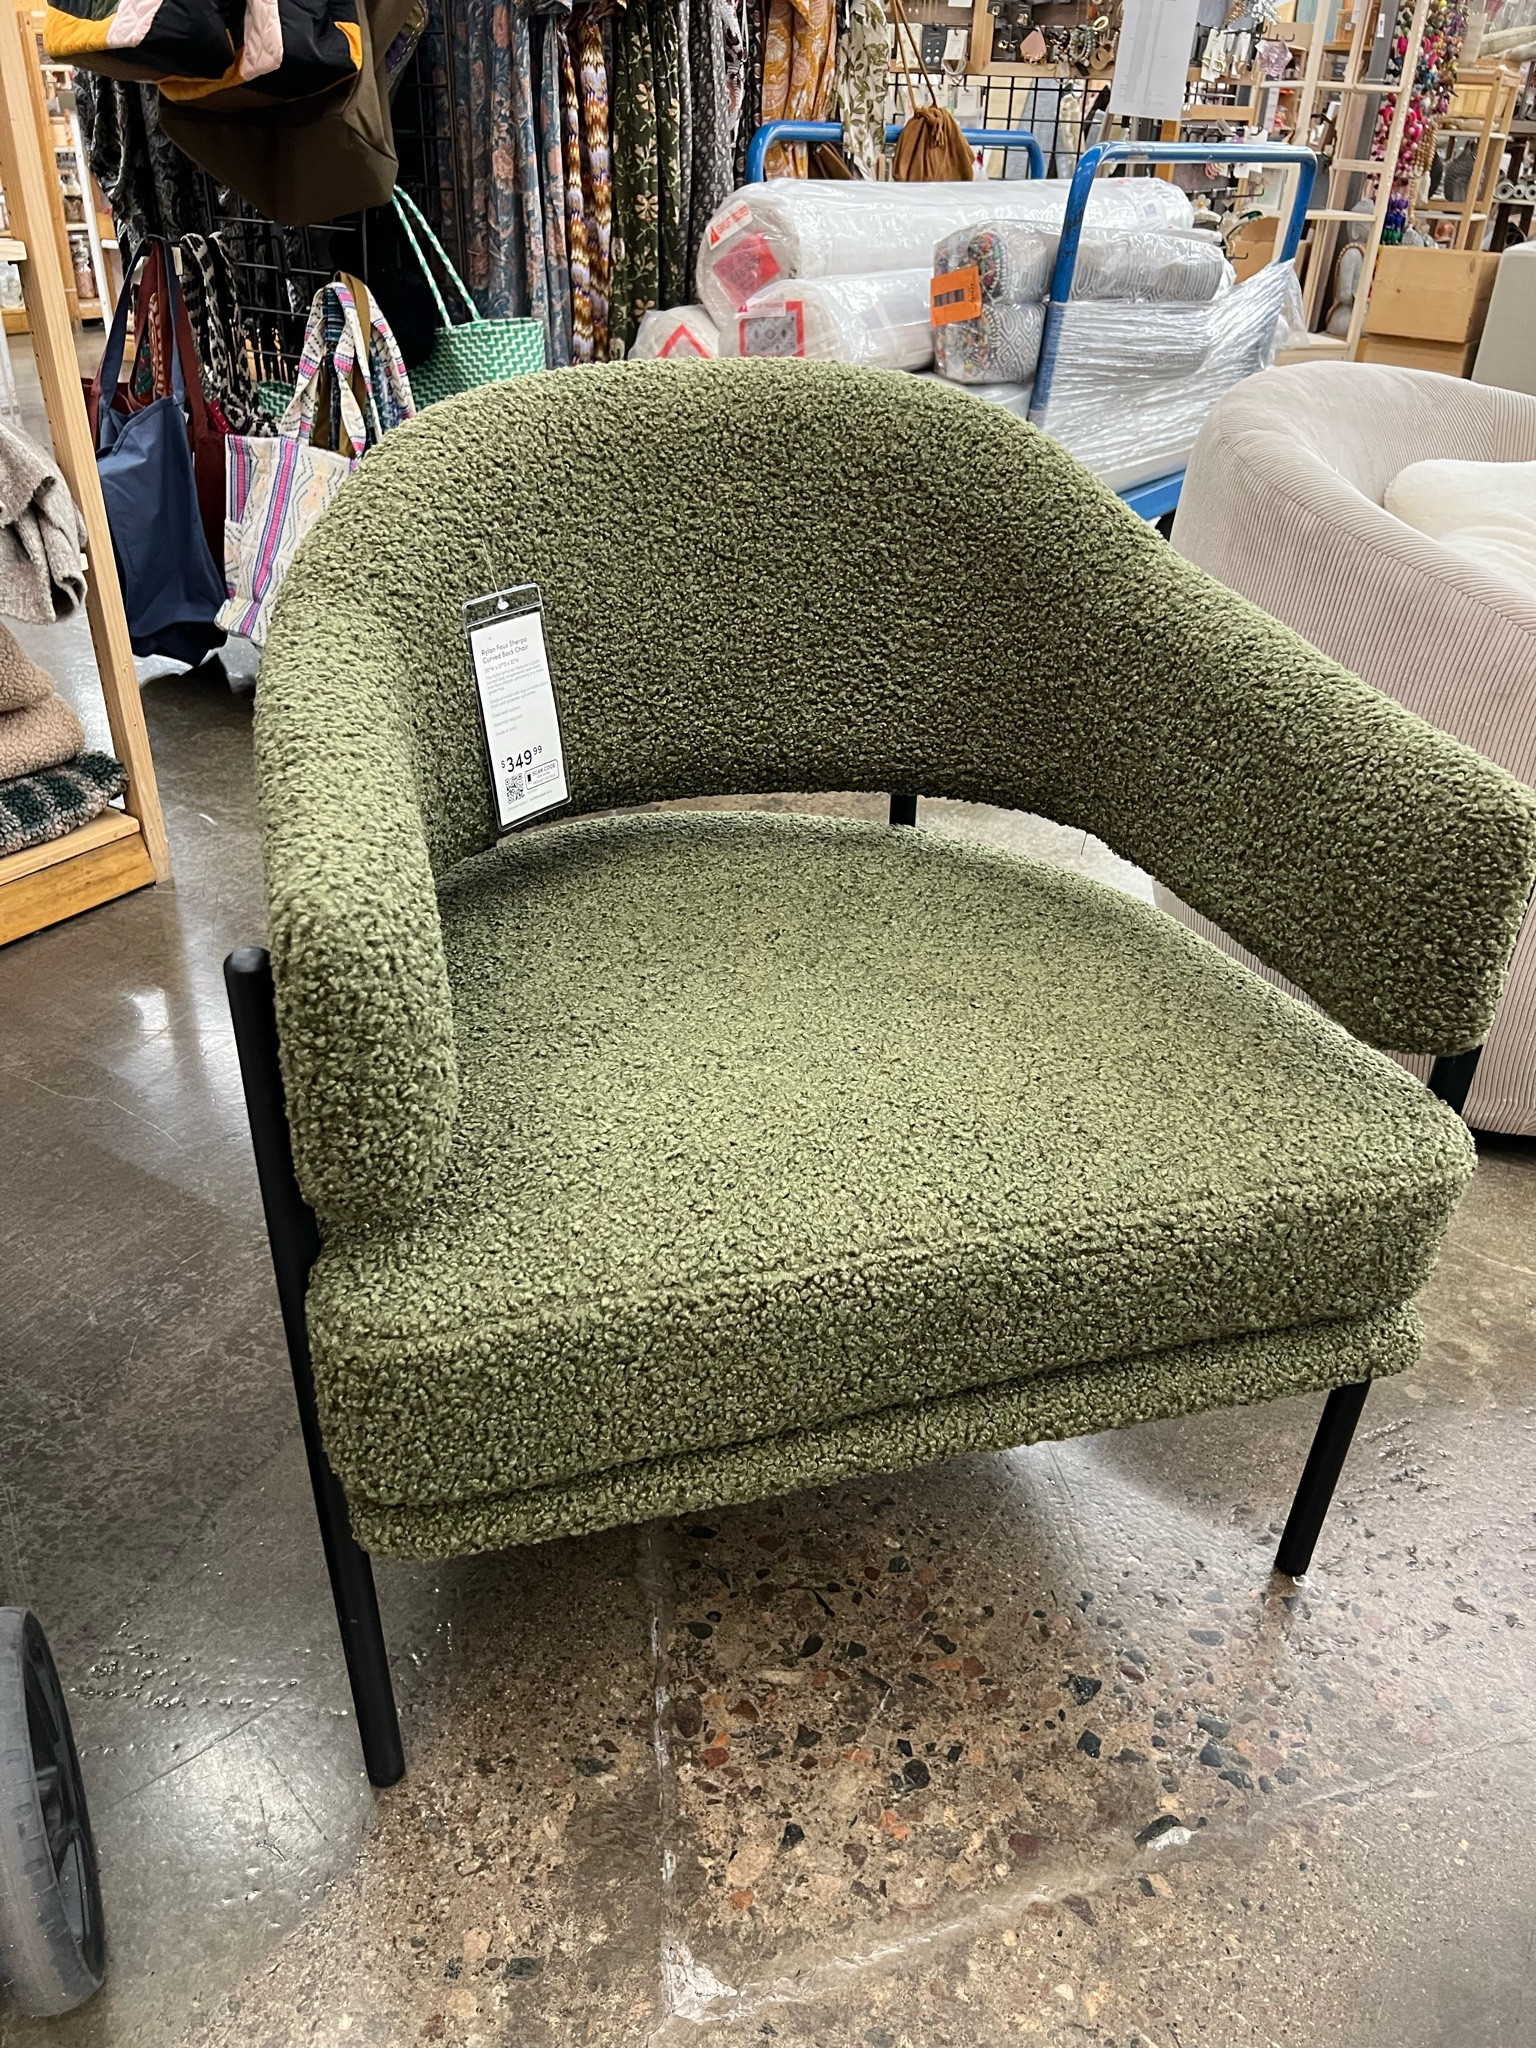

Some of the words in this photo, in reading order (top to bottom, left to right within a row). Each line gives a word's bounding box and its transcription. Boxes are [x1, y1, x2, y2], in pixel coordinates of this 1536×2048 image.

[481, 648, 496, 657] Rylan
[509, 637, 527, 647] Sherpa
[482, 653, 501, 664] Curved
[502, 649, 514, 657] Back
[514, 645, 528, 653] Chair
